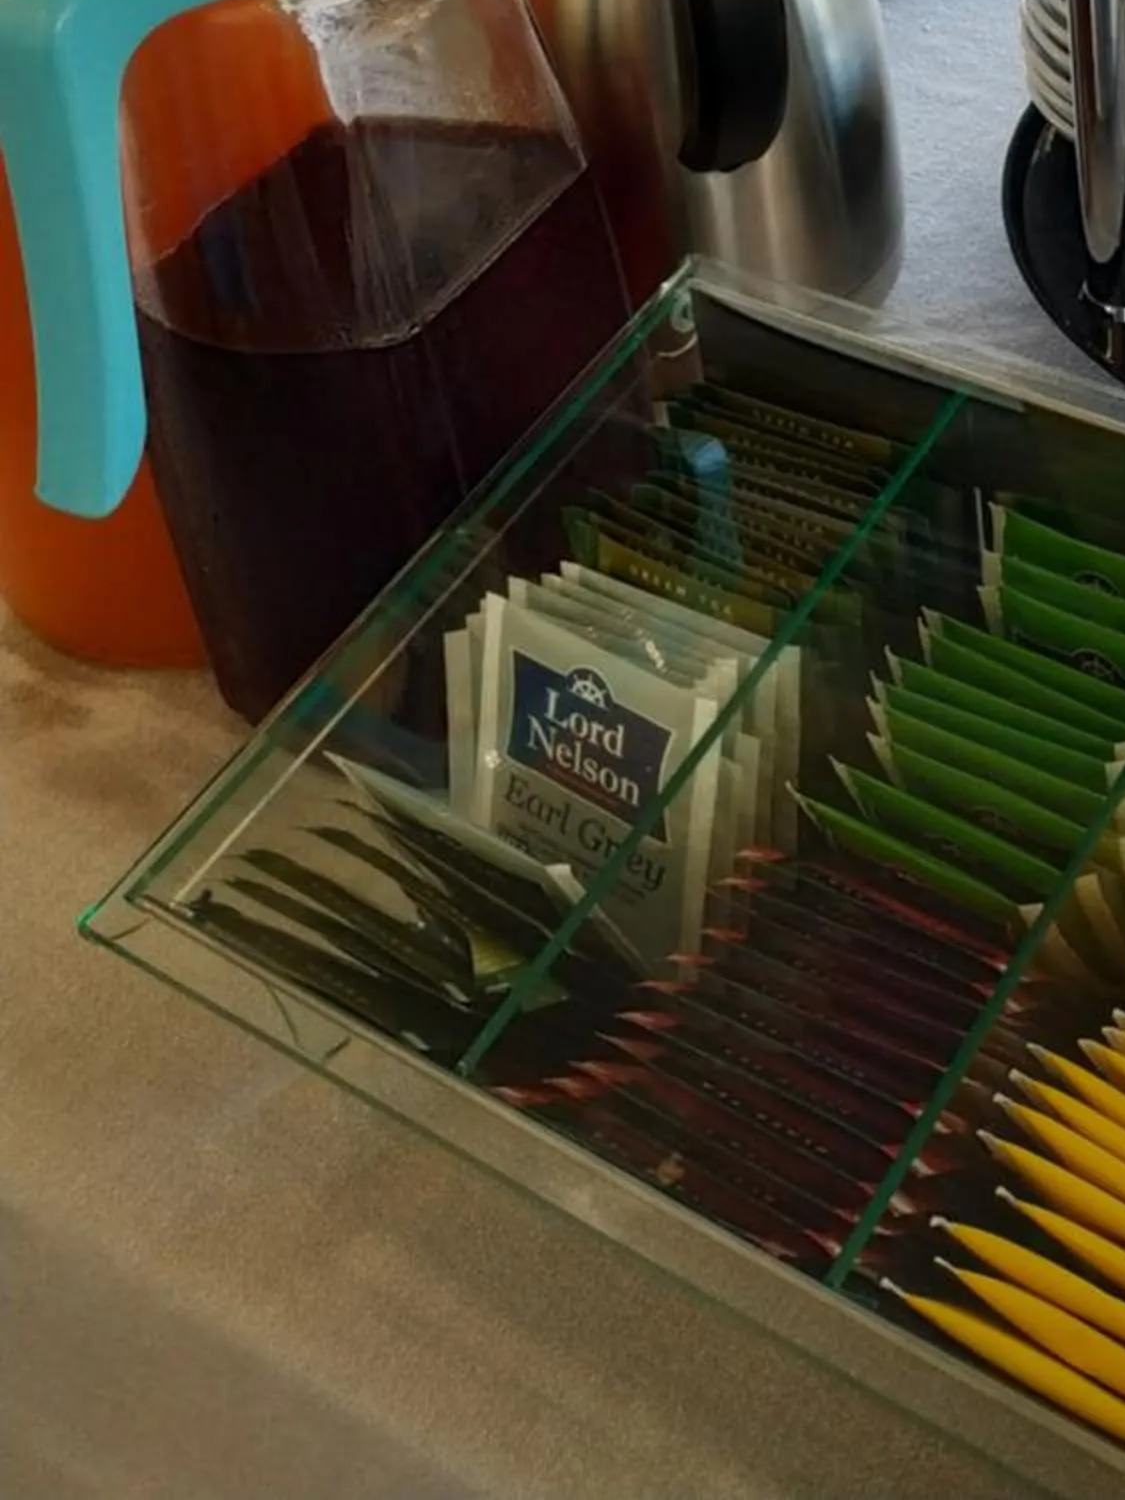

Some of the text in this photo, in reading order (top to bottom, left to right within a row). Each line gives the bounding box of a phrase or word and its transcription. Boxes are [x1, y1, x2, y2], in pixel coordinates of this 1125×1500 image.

[527, 714, 640, 807] Nelson
[544, 687, 625, 758] Lord
[505, 774, 571, 837] Earl
[577, 820, 666, 892] Grey
